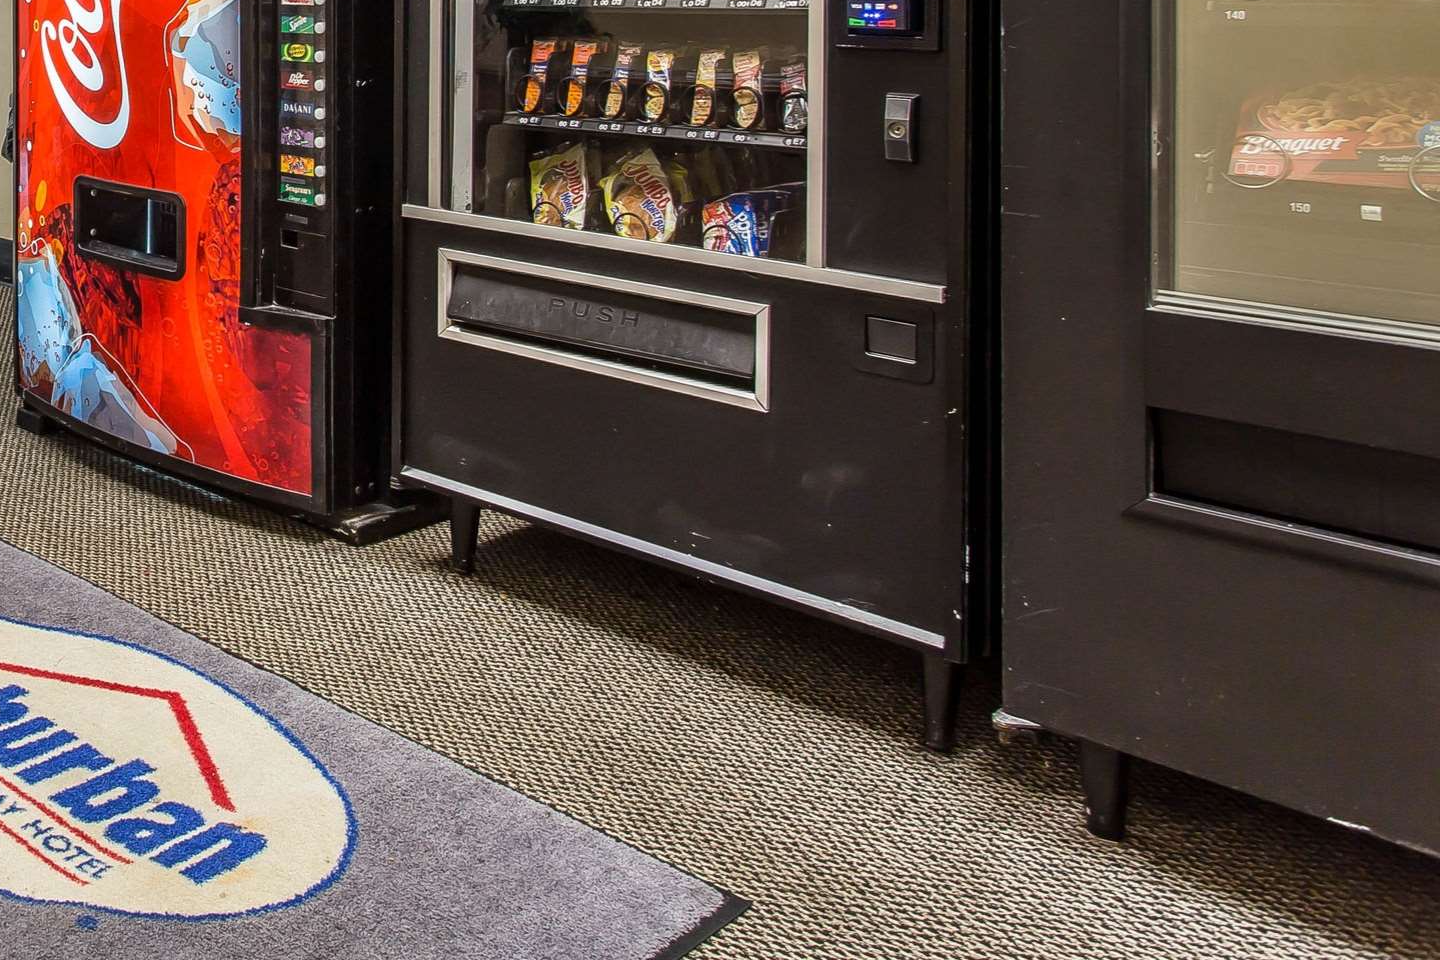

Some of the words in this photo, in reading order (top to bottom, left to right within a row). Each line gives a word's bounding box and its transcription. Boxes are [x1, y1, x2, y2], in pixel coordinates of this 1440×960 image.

[283, 103, 311, 115] DASANI
[1240, 135, 1350, 155] Banquet
[560, 160, 583, 206] JUMBO
[623, 165, 670, 211] JUMBO
[1289, 202, 1311, 213] 150
[547, 297, 639, 327] PUSH
[19, 817, 120, 880] HOTEL
